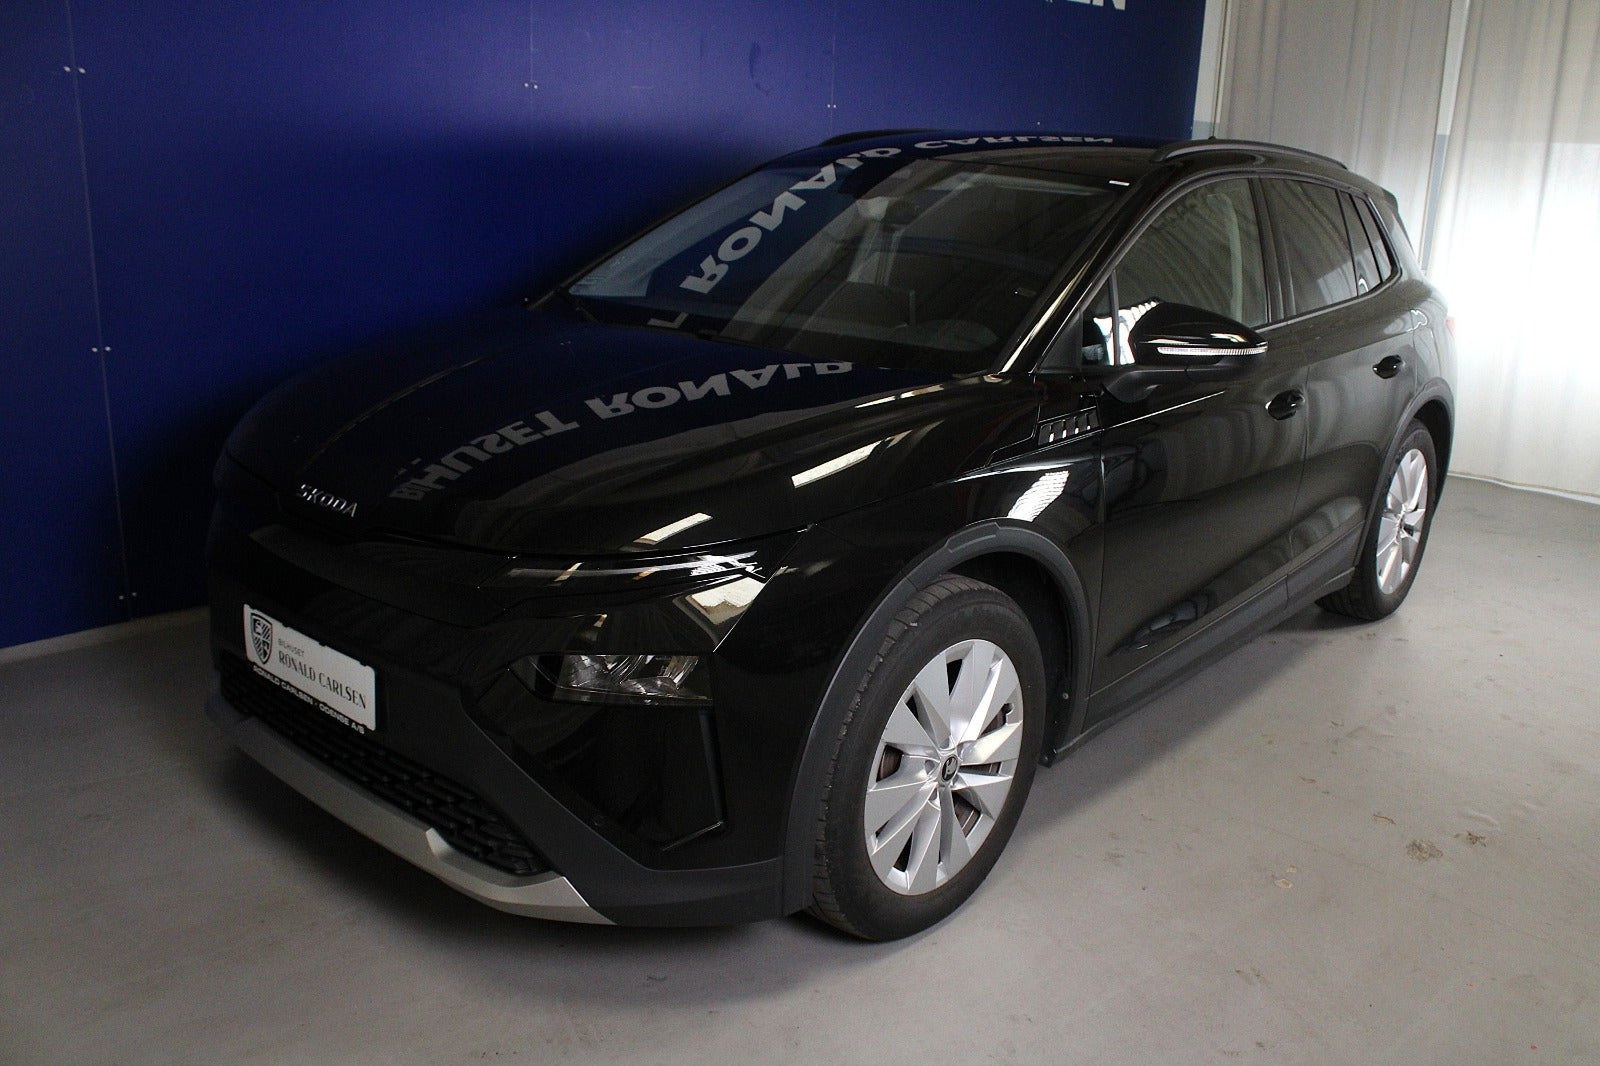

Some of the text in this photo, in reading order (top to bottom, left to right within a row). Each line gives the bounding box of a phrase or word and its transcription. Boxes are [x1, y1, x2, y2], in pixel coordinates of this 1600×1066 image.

[278, 650, 366, 709] RONALD CARLSEN
[281, 681, 314, 705] CARLSEN
